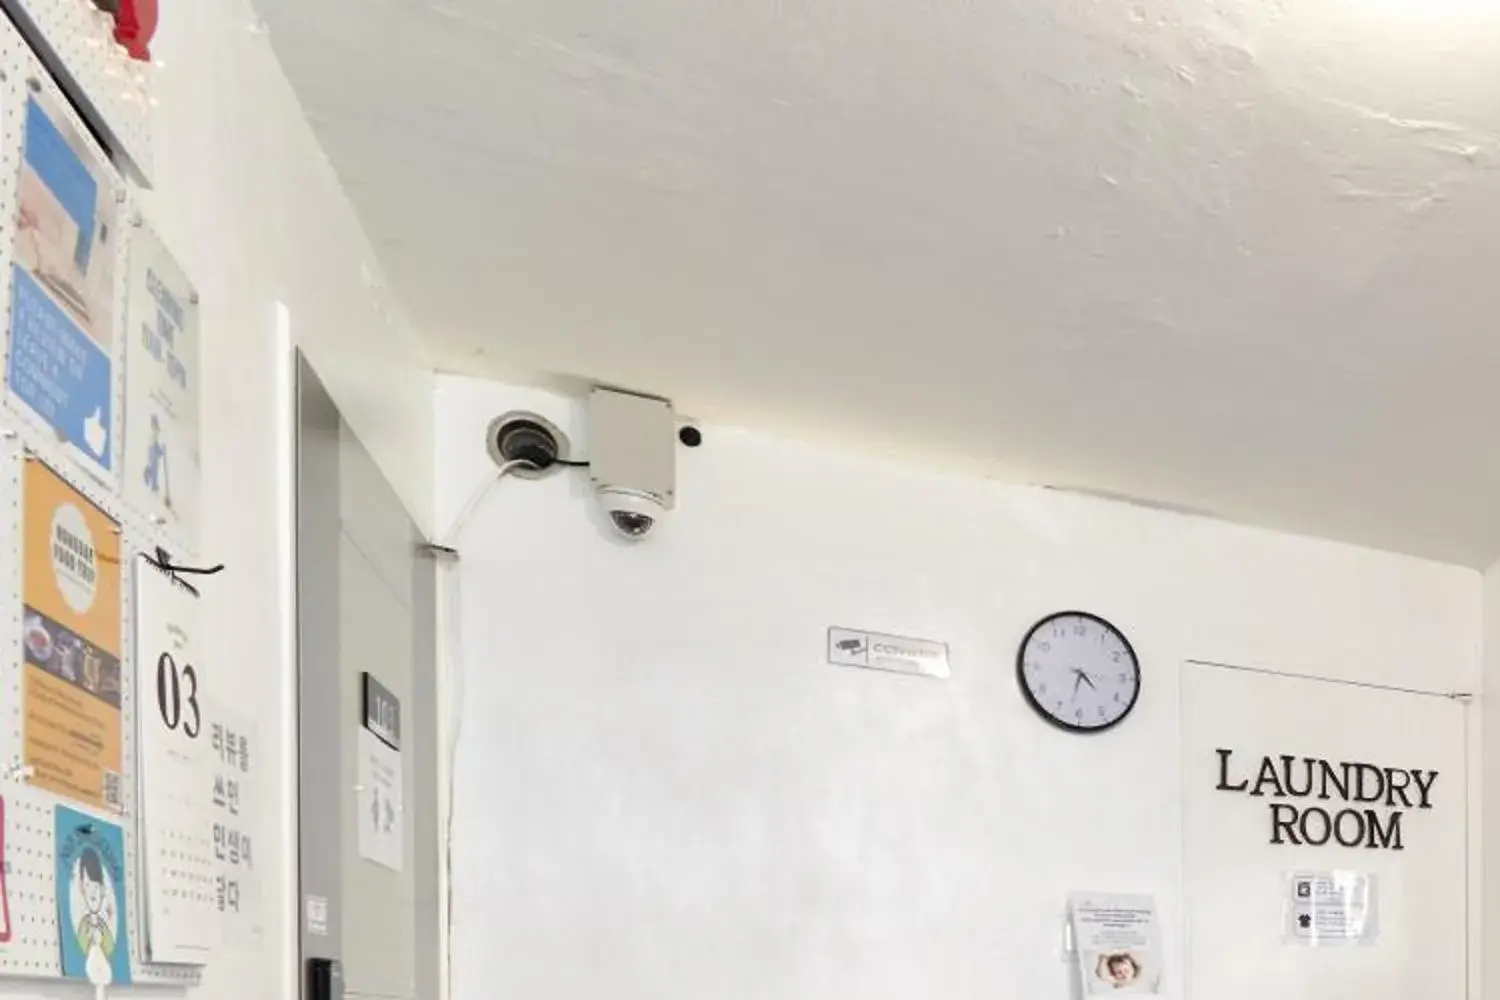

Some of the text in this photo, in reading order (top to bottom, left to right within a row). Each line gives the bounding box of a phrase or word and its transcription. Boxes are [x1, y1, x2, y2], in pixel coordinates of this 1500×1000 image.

[157, 651, 201, 739] 03
[1215, 748, 1439, 809] LAUNDRY
[1269, 803, 1405, 850] ROOM
